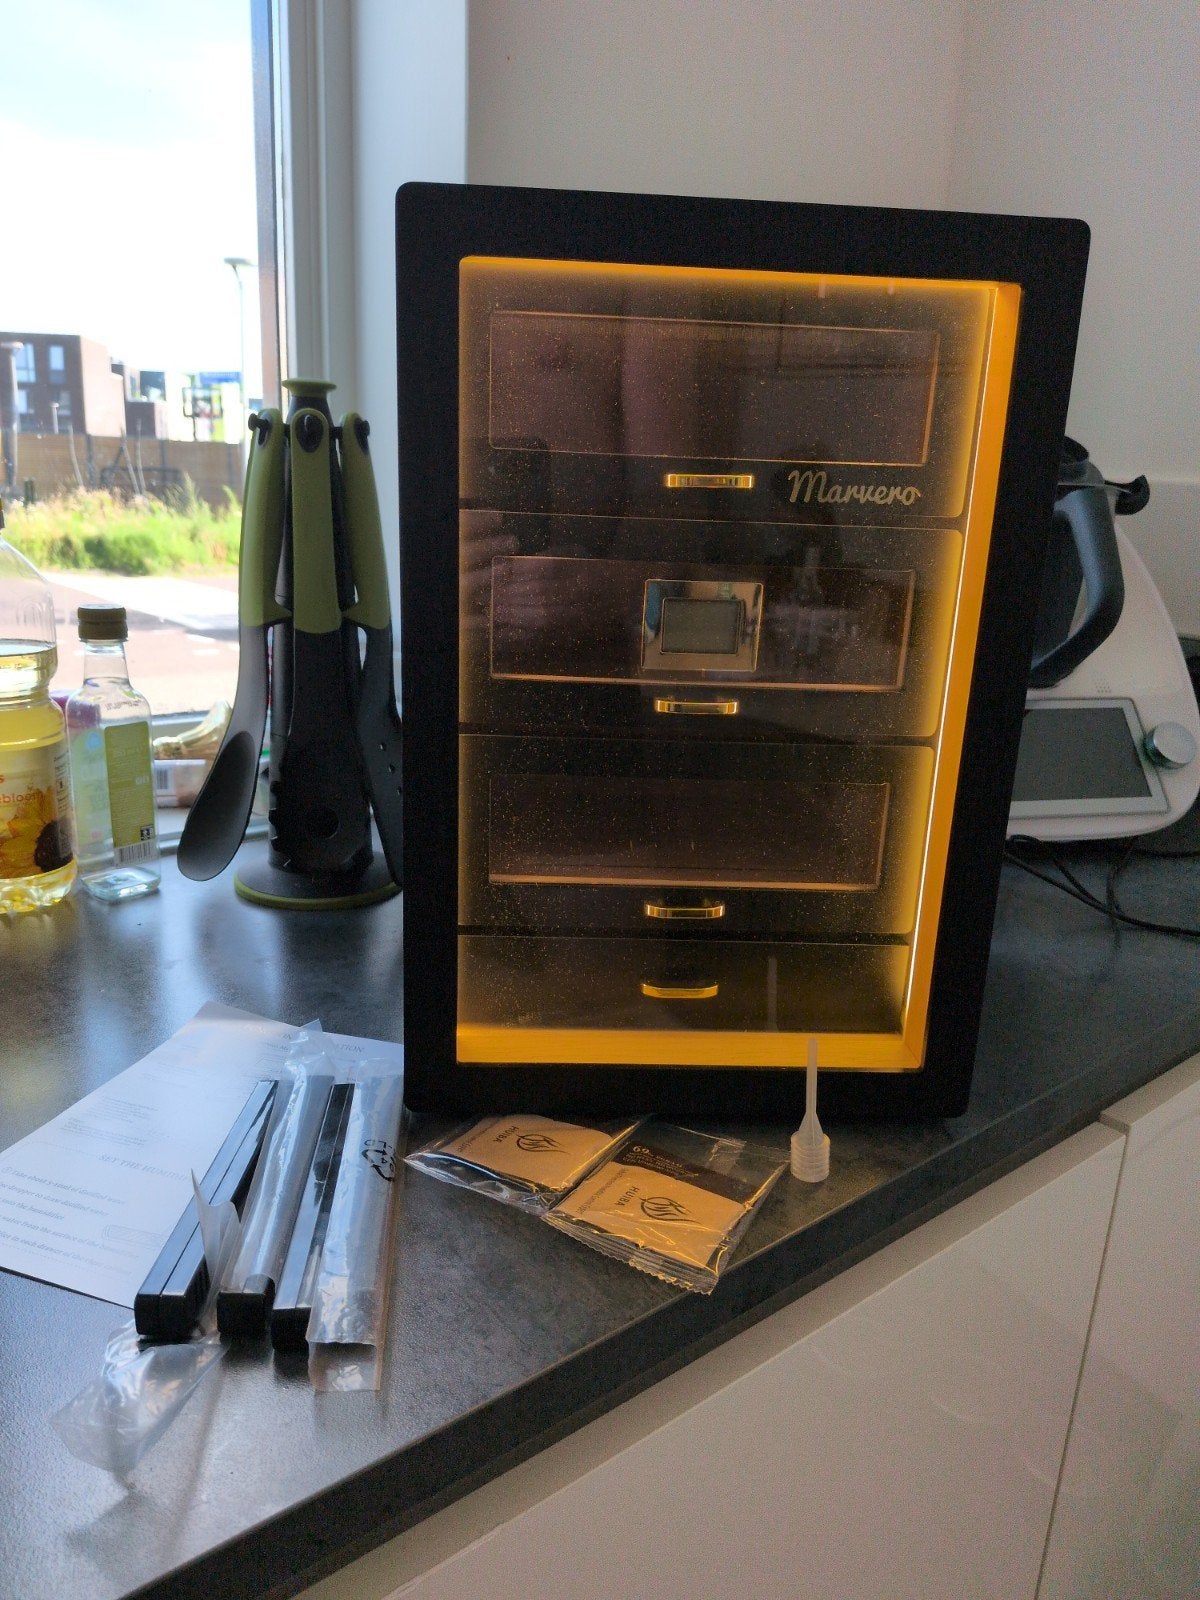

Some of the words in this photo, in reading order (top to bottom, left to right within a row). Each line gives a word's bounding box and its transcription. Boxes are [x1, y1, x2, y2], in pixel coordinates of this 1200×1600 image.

[788, 469, 922, 506] Marvero
[493, 1125, 519, 1143] HUIBA
[615, 1185, 640, 1206] HUIBA
